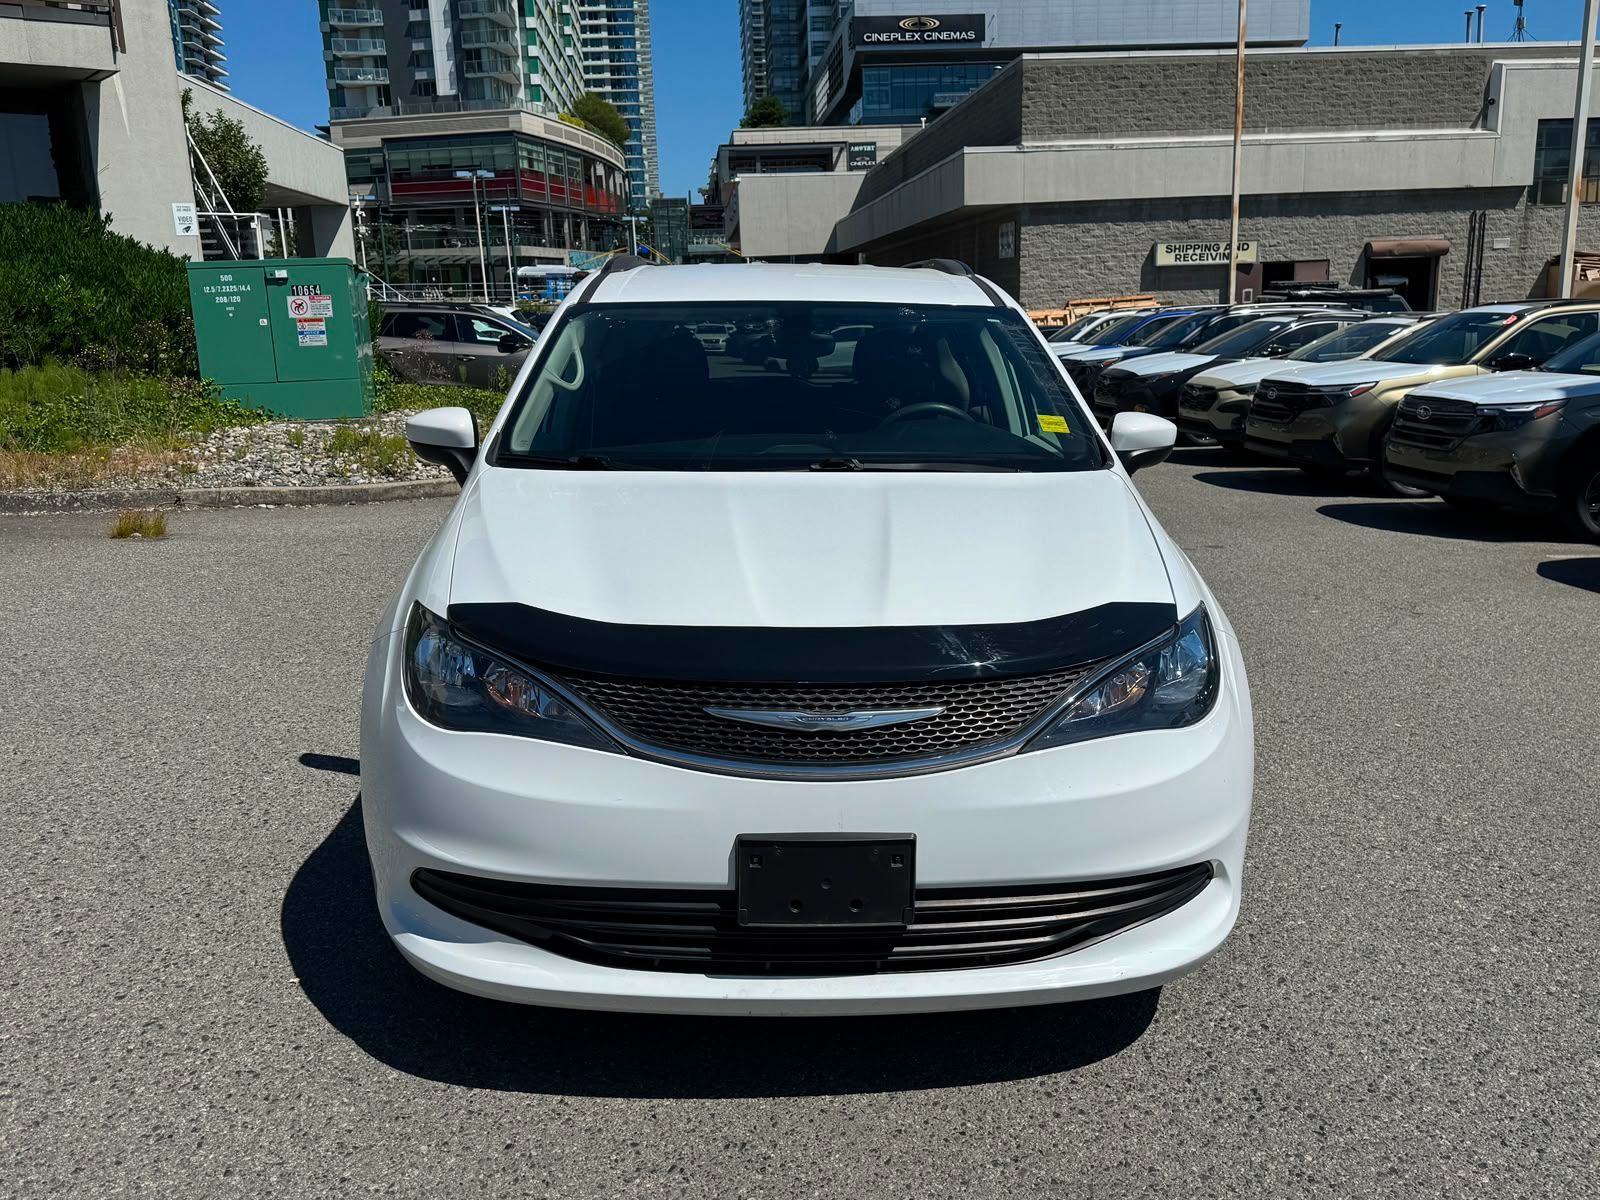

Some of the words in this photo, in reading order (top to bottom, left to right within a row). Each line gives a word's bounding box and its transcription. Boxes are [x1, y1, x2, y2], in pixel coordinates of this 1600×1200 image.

[863, 32, 921, 42] CINEPLEX
[923, 30, 976, 41] CINEMAS
[177, 215, 193, 223] VIDEO
[1165, 243, 1220, 254] SHIPPING
[1174, 252, 1239, 262] RECEIVIN
[220, 274, 233, 282] 500
[292, 284, 321, 296] 10654
[215, 295, 241, 303] 208/120
